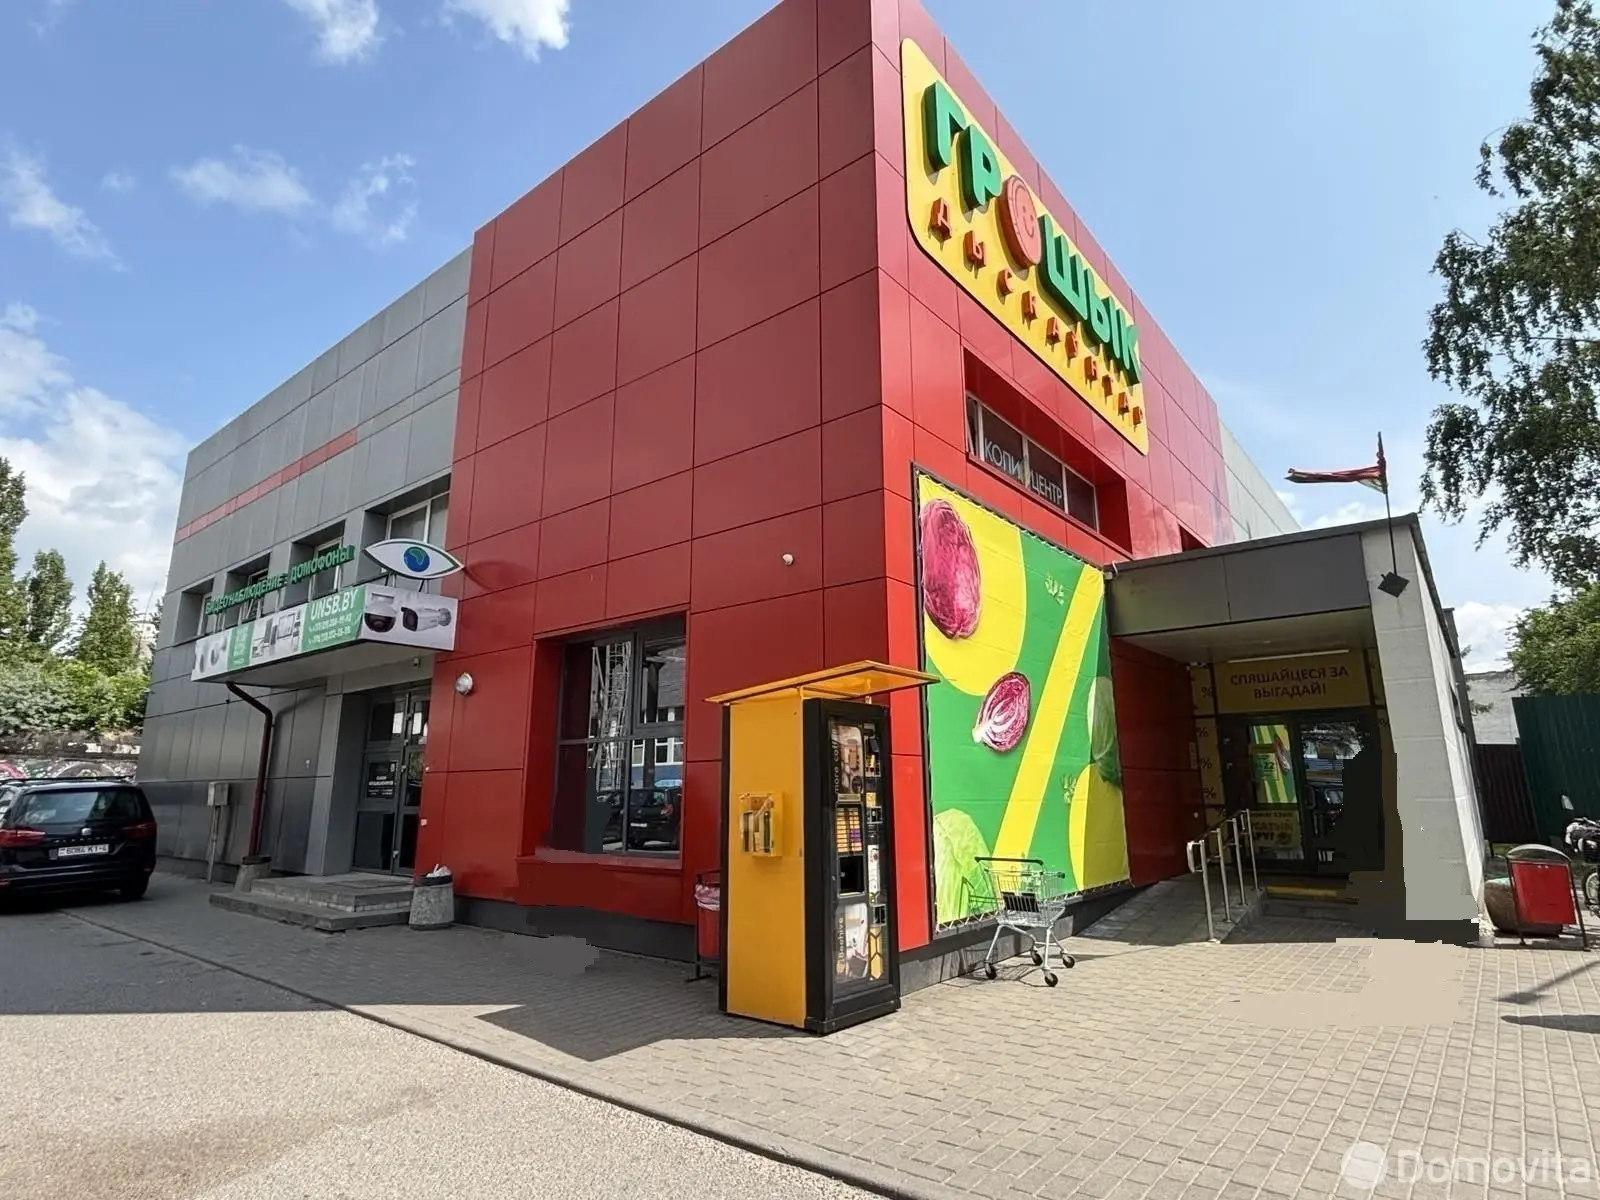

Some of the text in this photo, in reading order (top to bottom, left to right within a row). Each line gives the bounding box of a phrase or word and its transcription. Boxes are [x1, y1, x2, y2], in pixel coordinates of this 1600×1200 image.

[291, 546, 355, 585] ДОМОФОНЫ
[310, 589, 357, 620] UNSB.BY
[1230, 665, 1349, 686] СПЯШАЙЦЕСЯ ЗА
[1253, 682, 1327, 700] ВЫГАДАЙ!
